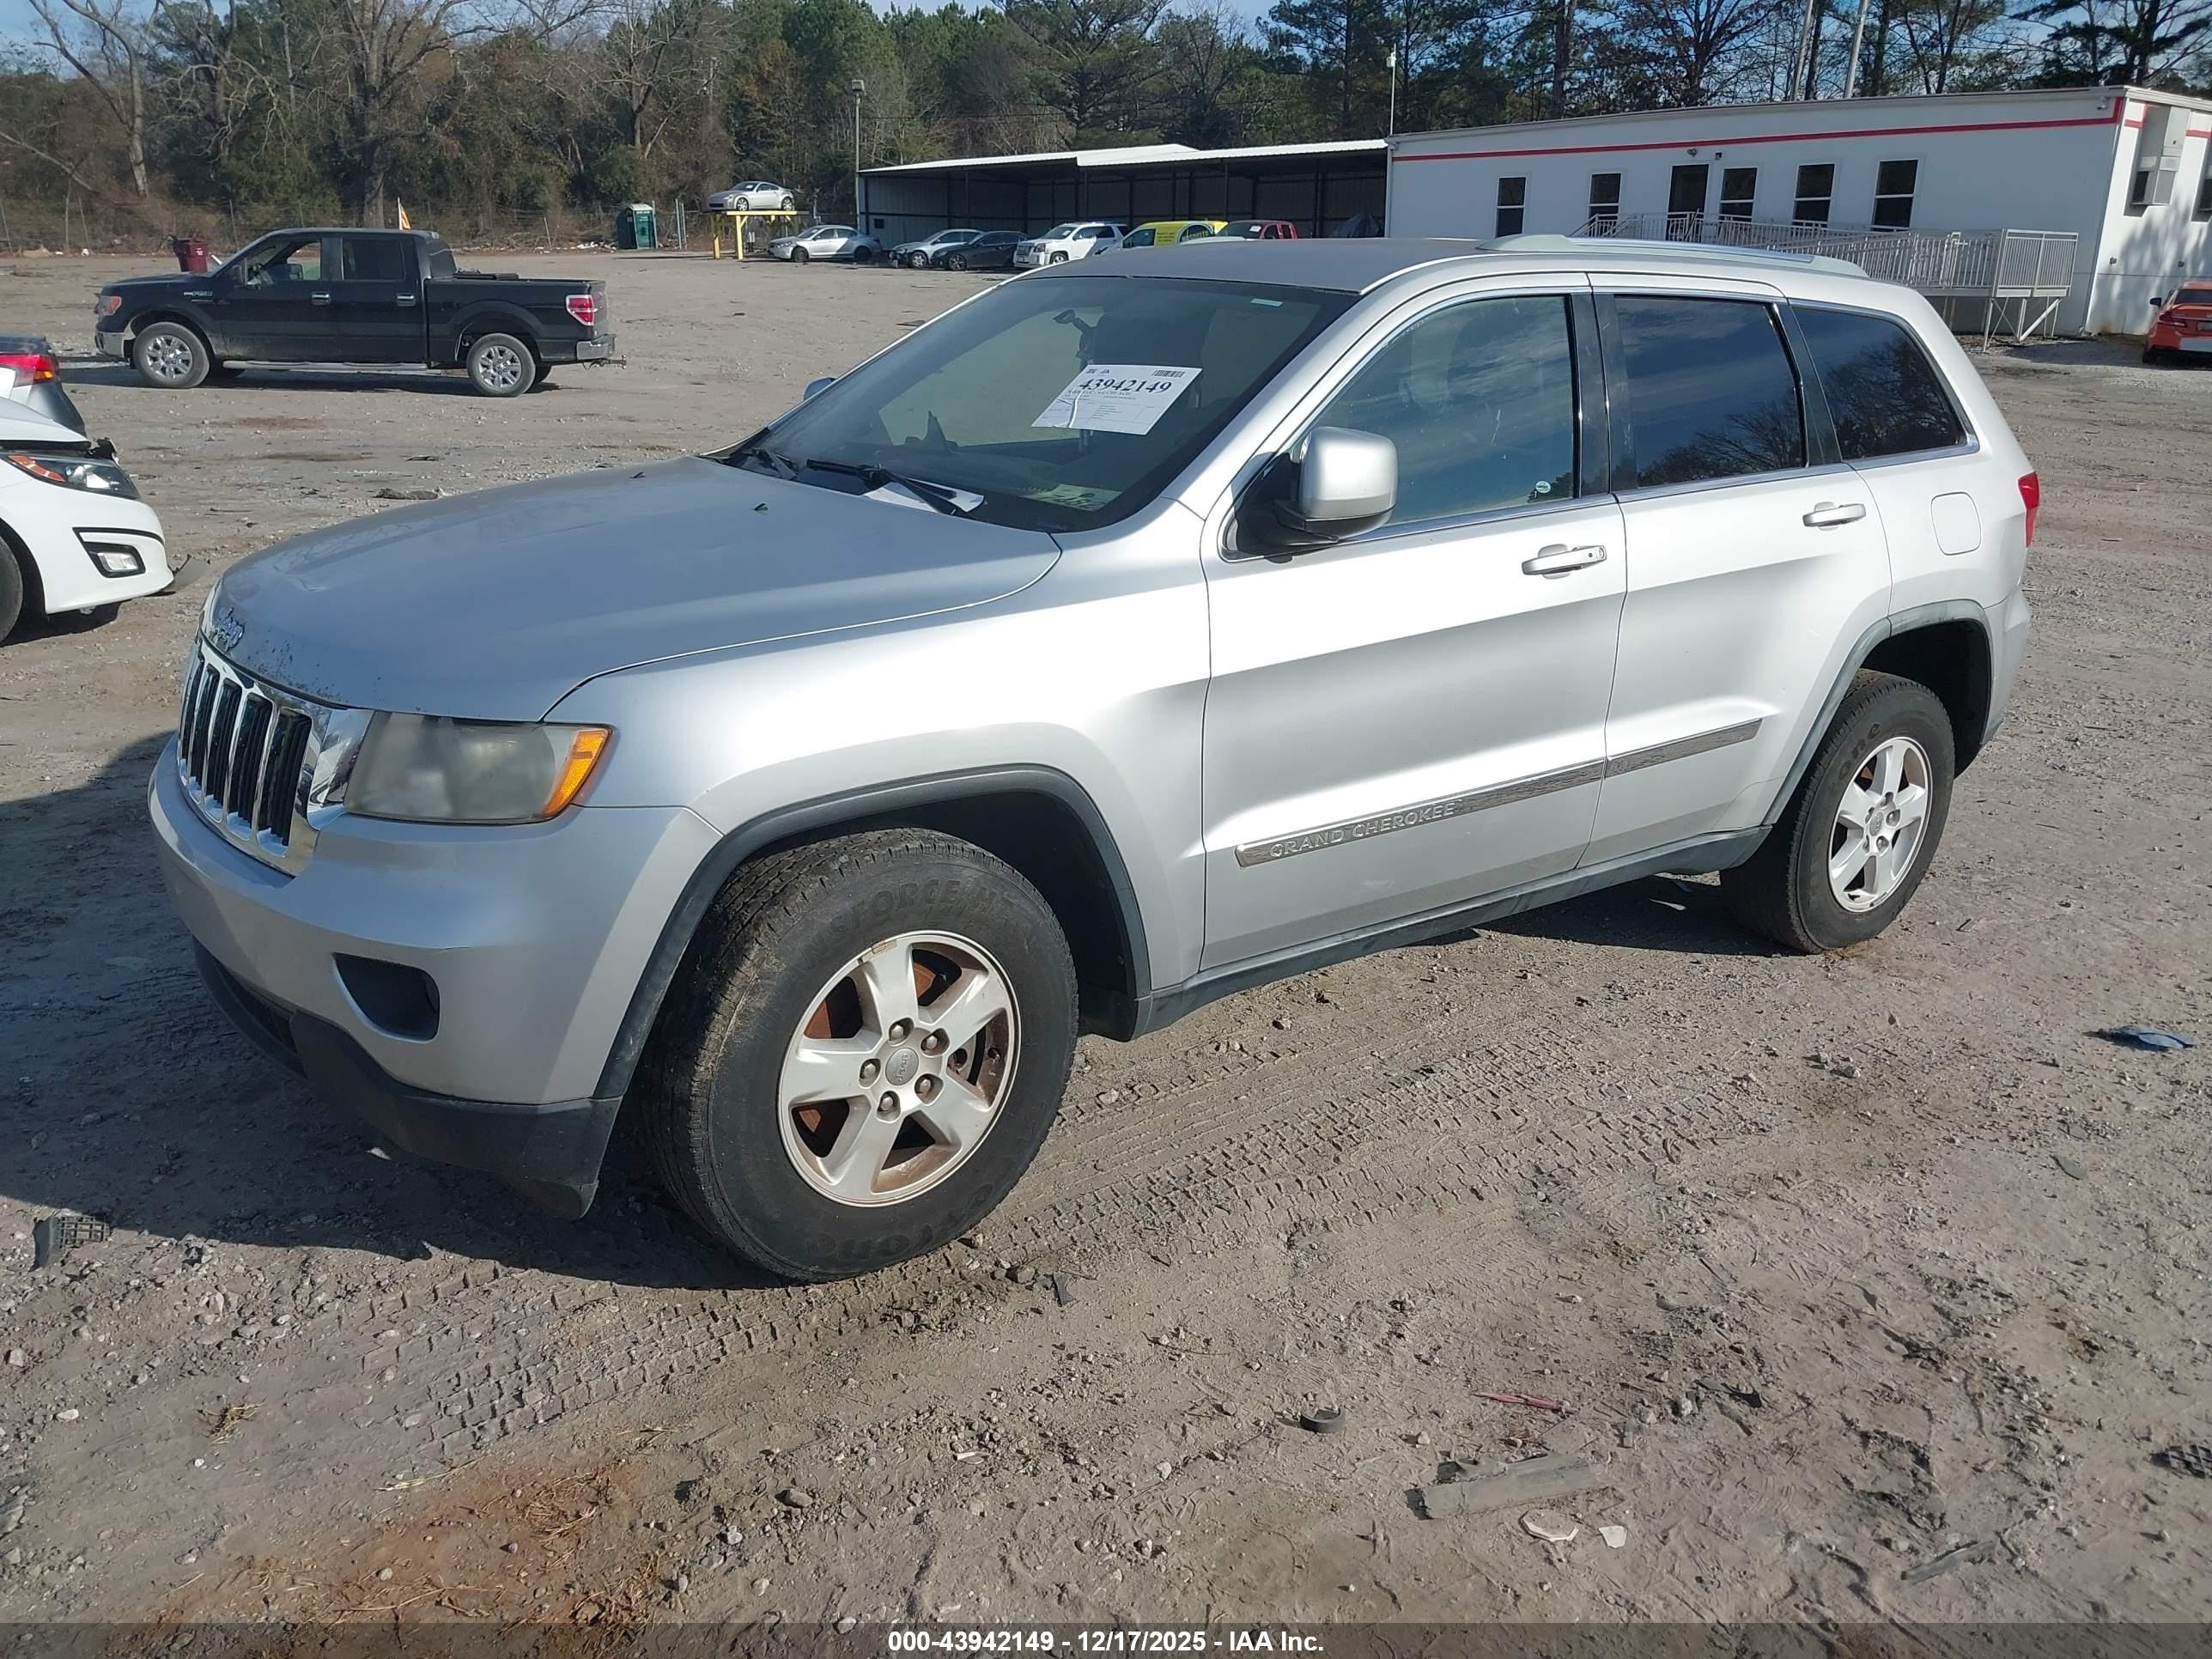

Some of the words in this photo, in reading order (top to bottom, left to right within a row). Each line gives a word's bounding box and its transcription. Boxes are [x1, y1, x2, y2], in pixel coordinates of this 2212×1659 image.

[1079, 378, 1172, 394] 43942149
[1269, 828, 1345, 858] GRAND
[1352, 801, 1458, 838] CHEROKEE
